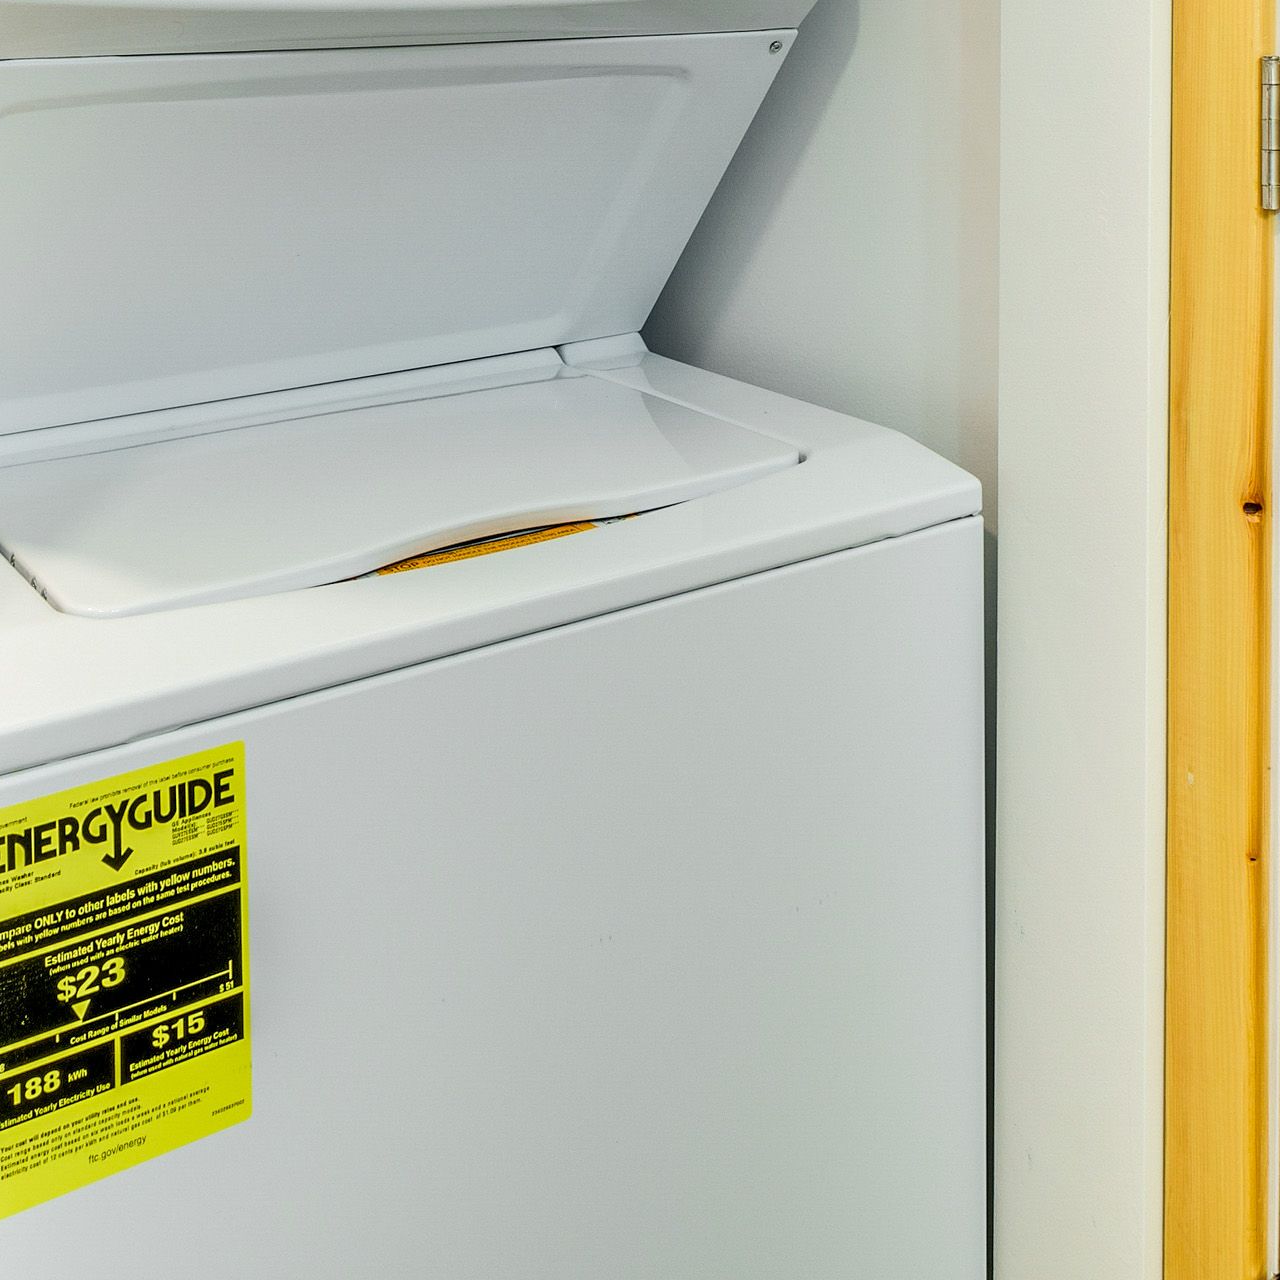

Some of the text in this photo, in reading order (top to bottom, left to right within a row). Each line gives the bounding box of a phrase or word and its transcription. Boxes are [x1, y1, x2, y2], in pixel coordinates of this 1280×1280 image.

[12, 872, 34, 882] Washer
[34, 910, 64, 929] ONLY
[65, 909, 76, 920] to
[78, 900, 104, 915] other
[106, 889, 136, 907] labels
[137, 881, 158, 896] with
[160, 872, 190, 891] yellow
[192, 858, 235, 878] numbers.
[16, 935, 33, 946] with
[34, 927, 60, 943] yellow
[60, 916, 94, 932] numbers
[95, 911, 107, 921] are
[108, 902, 131, 916] based
[132, 900, 142, 909] on
[142, 896, 155, 905] the
[156, 889, 175, 901] same
[176, 883, 190, 894] test
[190, 871, 232, 891] procedures.
[44, 912, 184, 967] Estimated Yearly Energy Cost
[49, 924, 184, 976] (when used with an electric water heater)
[57, 957, 125, 1001] $23
[70, 1005, 167, 1045] Cost Range of Similar Models
[152, 1011, 205, 1048] $15
[129, 1028, 229, 1072] Estimated Yearly Energy Cost
[7, 1070, 61, 1105] 188
[68, 1068, 88, 1082] kWh
[34, 1102, 58, 1116] Yearly
[58, 1088, 95, 1107] Electricity
[96, 1083, 111, 1095] Use
[88, 1136, 146, 1163] ftc.gov/energy
